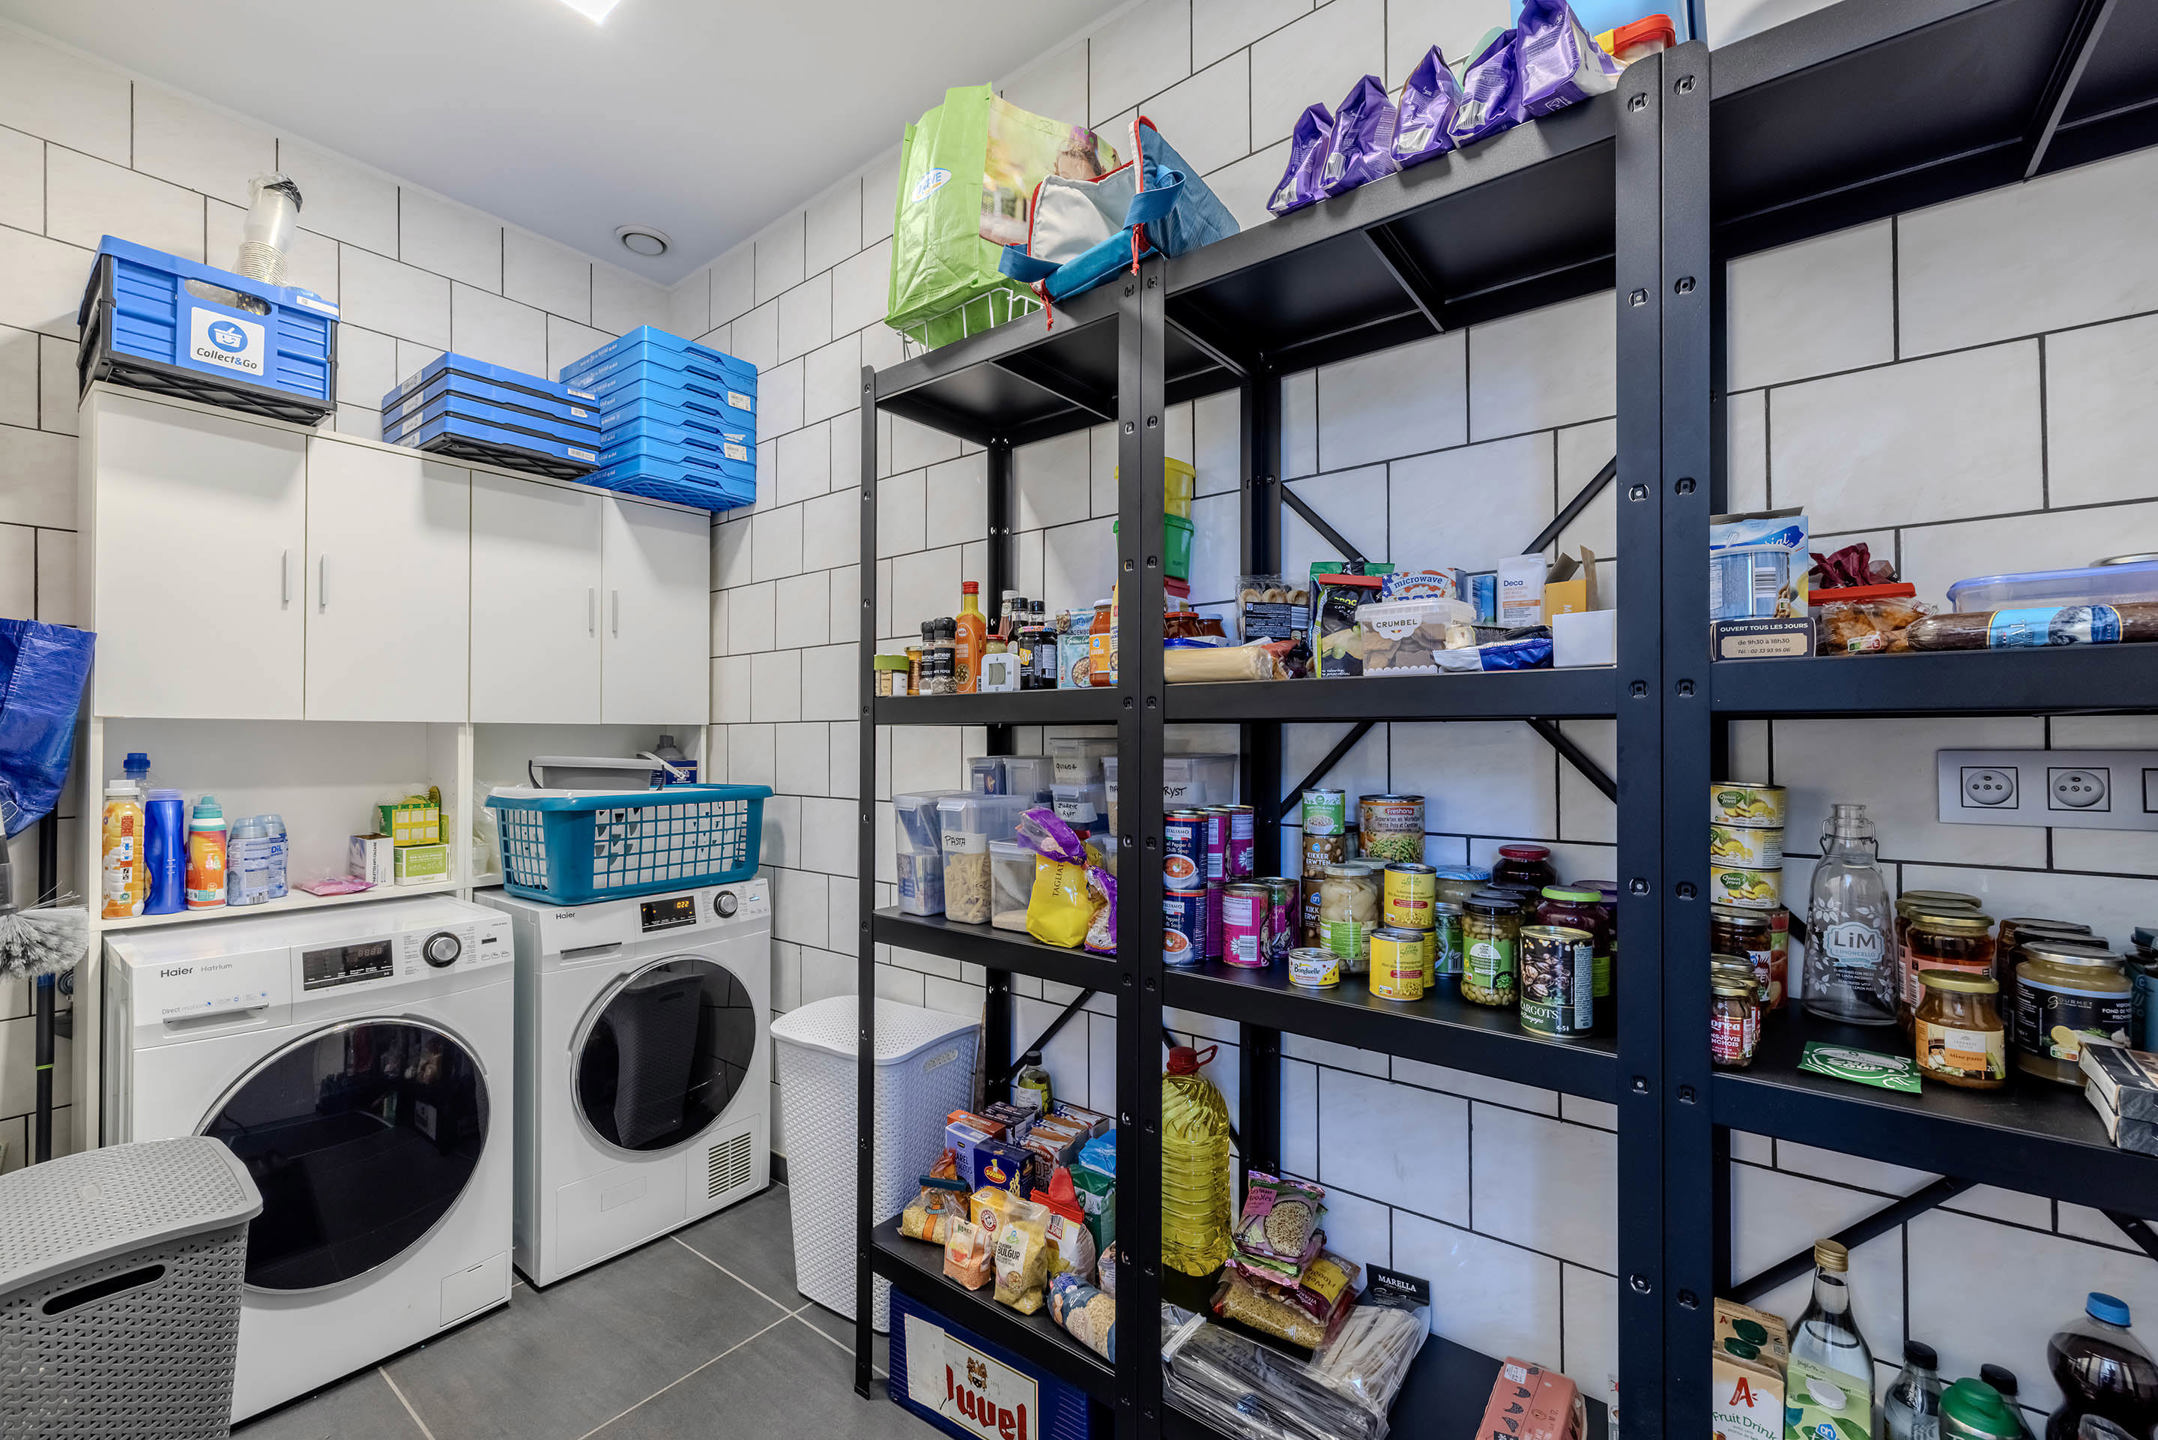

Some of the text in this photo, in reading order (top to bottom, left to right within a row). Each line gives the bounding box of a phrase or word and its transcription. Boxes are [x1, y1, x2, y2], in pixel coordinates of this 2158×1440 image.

[196, 346, 258, 370] Collect&Go
[1394, 575, 1443, 589] microwave
[1376, 619, 1418, 628] CRUMBEL
[1387, 807, 1413, 815] Freshona
[944, 835, 966, 847] PASTA
[1306, 858, 1331, 866] ERWTEN
[1307, 852, 1329, 860] KIKKER
[1052, 863, 1065, 897] TAGLIAT
[556, 911, 576, 920] Haier
[1304, 912, 1320, 920] ERWT
[1834, 930, 1876, 949] LiM
[1836, 948, 1876, 957] LIMONCELLO
[160, 966, 194, 978] Haier
[1294, 963, 1321, 975] Bonduelle
[997, 1247, 1021, 1261] BULGUR
[1378, 1274, 1417, 1292] MARELLA
[1711, 1411, 1778, 1440] Fruit Drink
